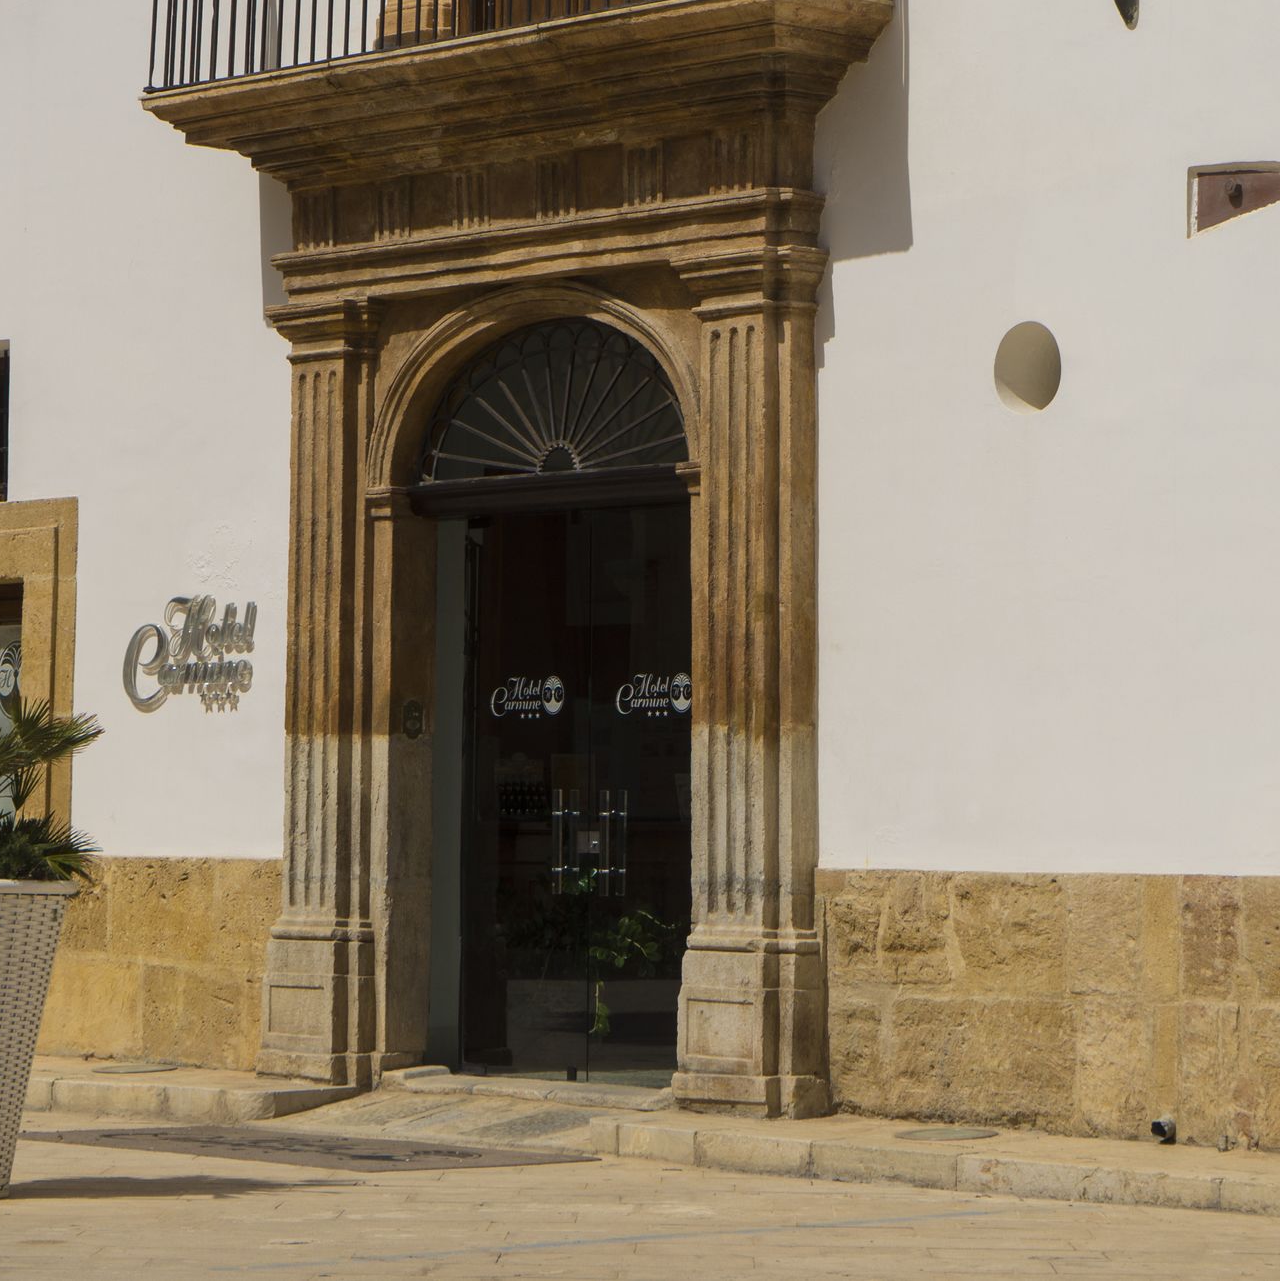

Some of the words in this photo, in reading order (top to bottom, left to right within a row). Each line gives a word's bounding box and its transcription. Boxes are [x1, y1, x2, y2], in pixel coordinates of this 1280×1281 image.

[164, 594, 257, 657] Hotel
[123, 623, 253, 709] Carmine
[507, 677, 542, 700] Hotel
[616, 684, 670, 715] Carmine
[633, 674, 670, 697] Hotel
[491, 687, 542, 717] Carmine
